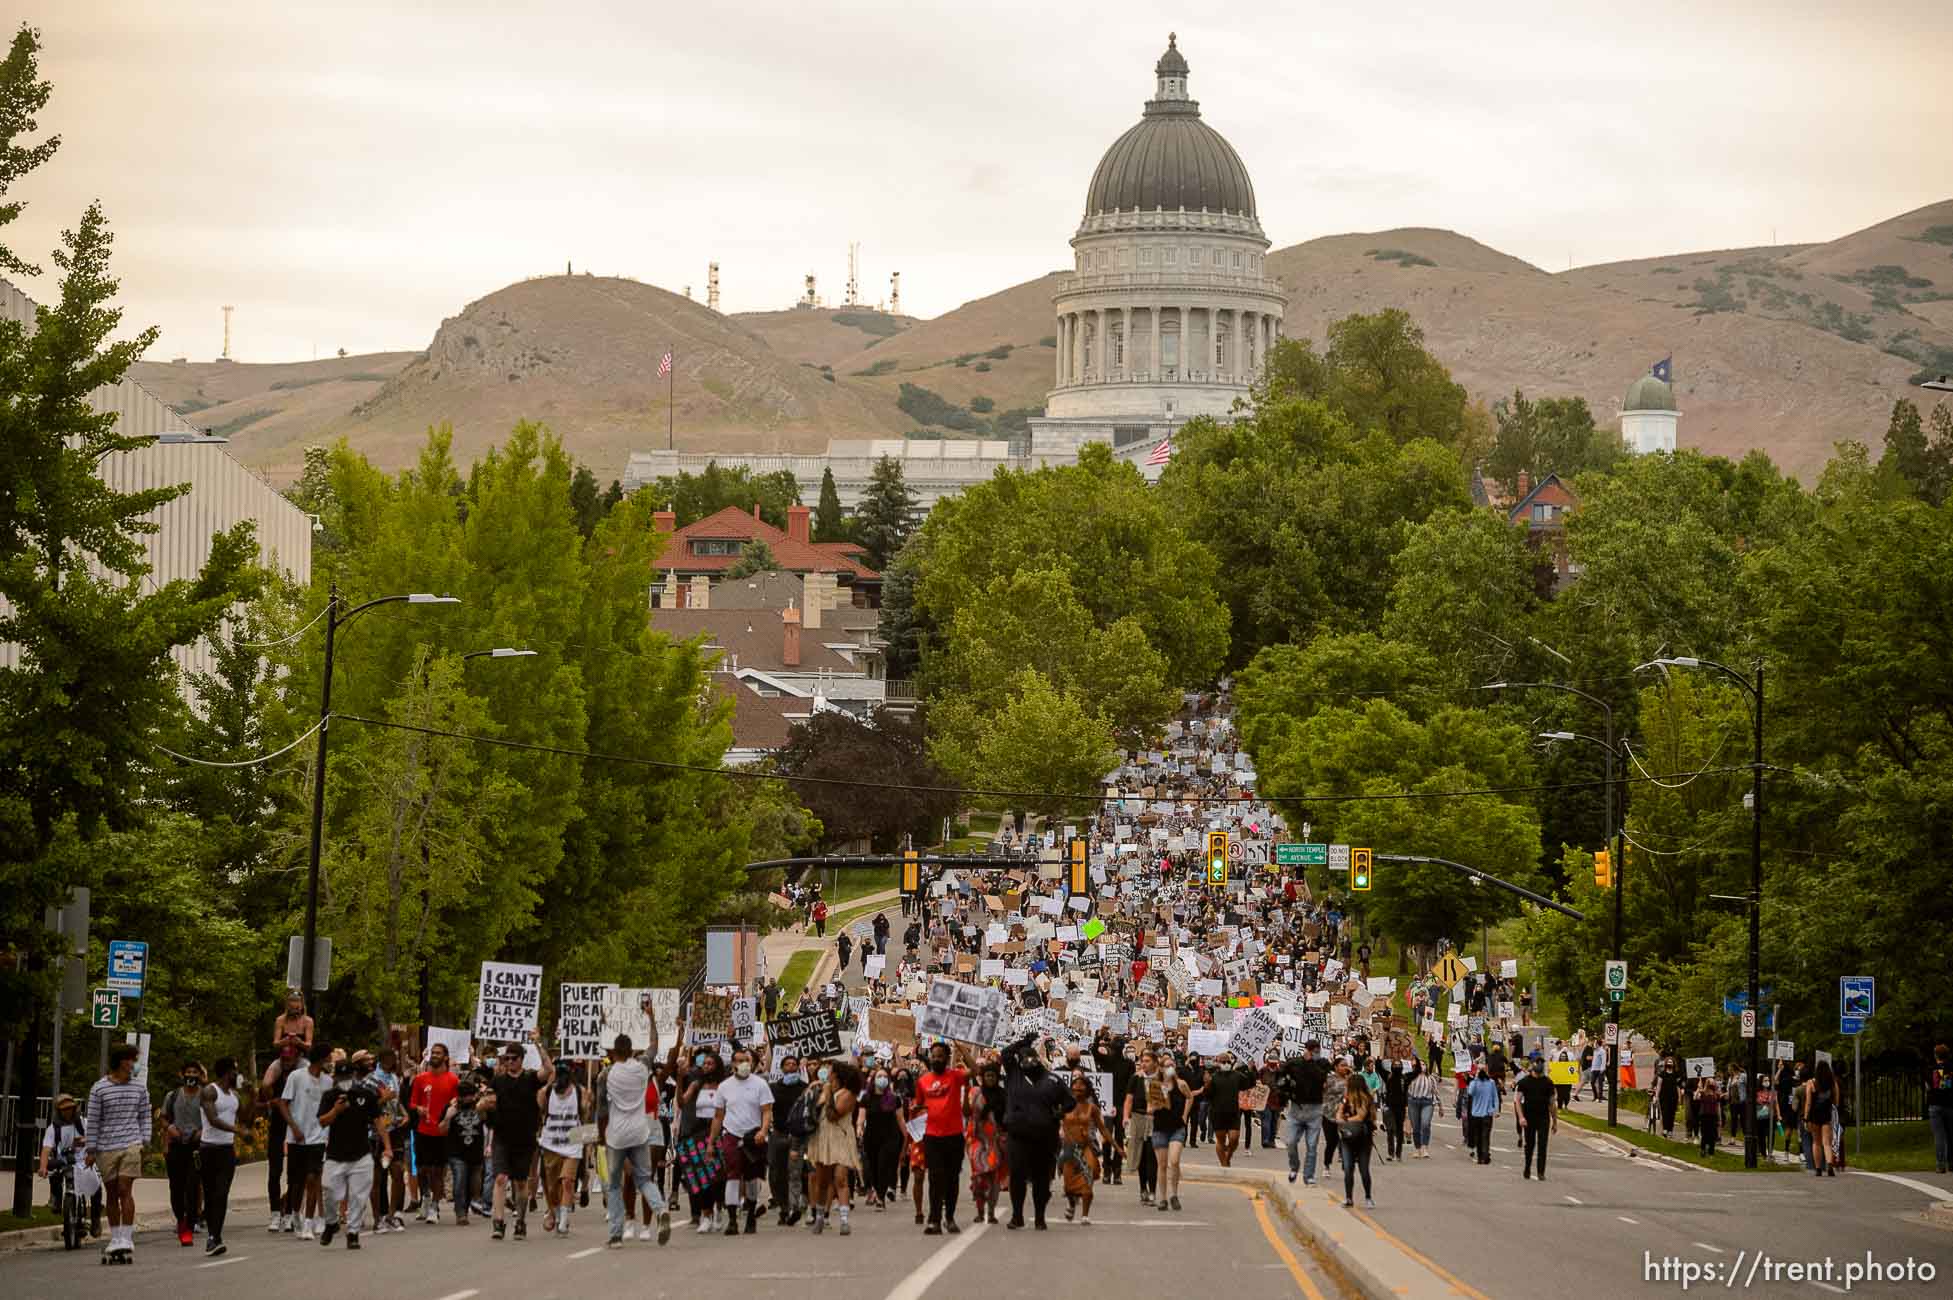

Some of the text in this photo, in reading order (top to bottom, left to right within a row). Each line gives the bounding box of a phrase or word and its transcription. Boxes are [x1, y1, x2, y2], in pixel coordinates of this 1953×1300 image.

[486, 970, 492, 983] I
[95, 994, 118, 1005] MILE
[484, 983, 538, 1002] BREATHE
[562, 985, 608, 1002] PUERT
[694, 992, 732, 1010] BLACK
[101, 1007, 111, 1022] 2
[484, 1002, 533, 1018] BLACK
[483, 1015, 523, 1029] LIVES
[788, 1012, 834, 1038] JUSTICE
[1251, 1008, 1280, 1033] HANDS
[480, 1026, 534, 1044] MATTE
[792, 1031, 839, 1057] PEACE
[563, 1038, 600, 1056] LIVE
[1228, 1041, 1253, 1061] SHOOT
